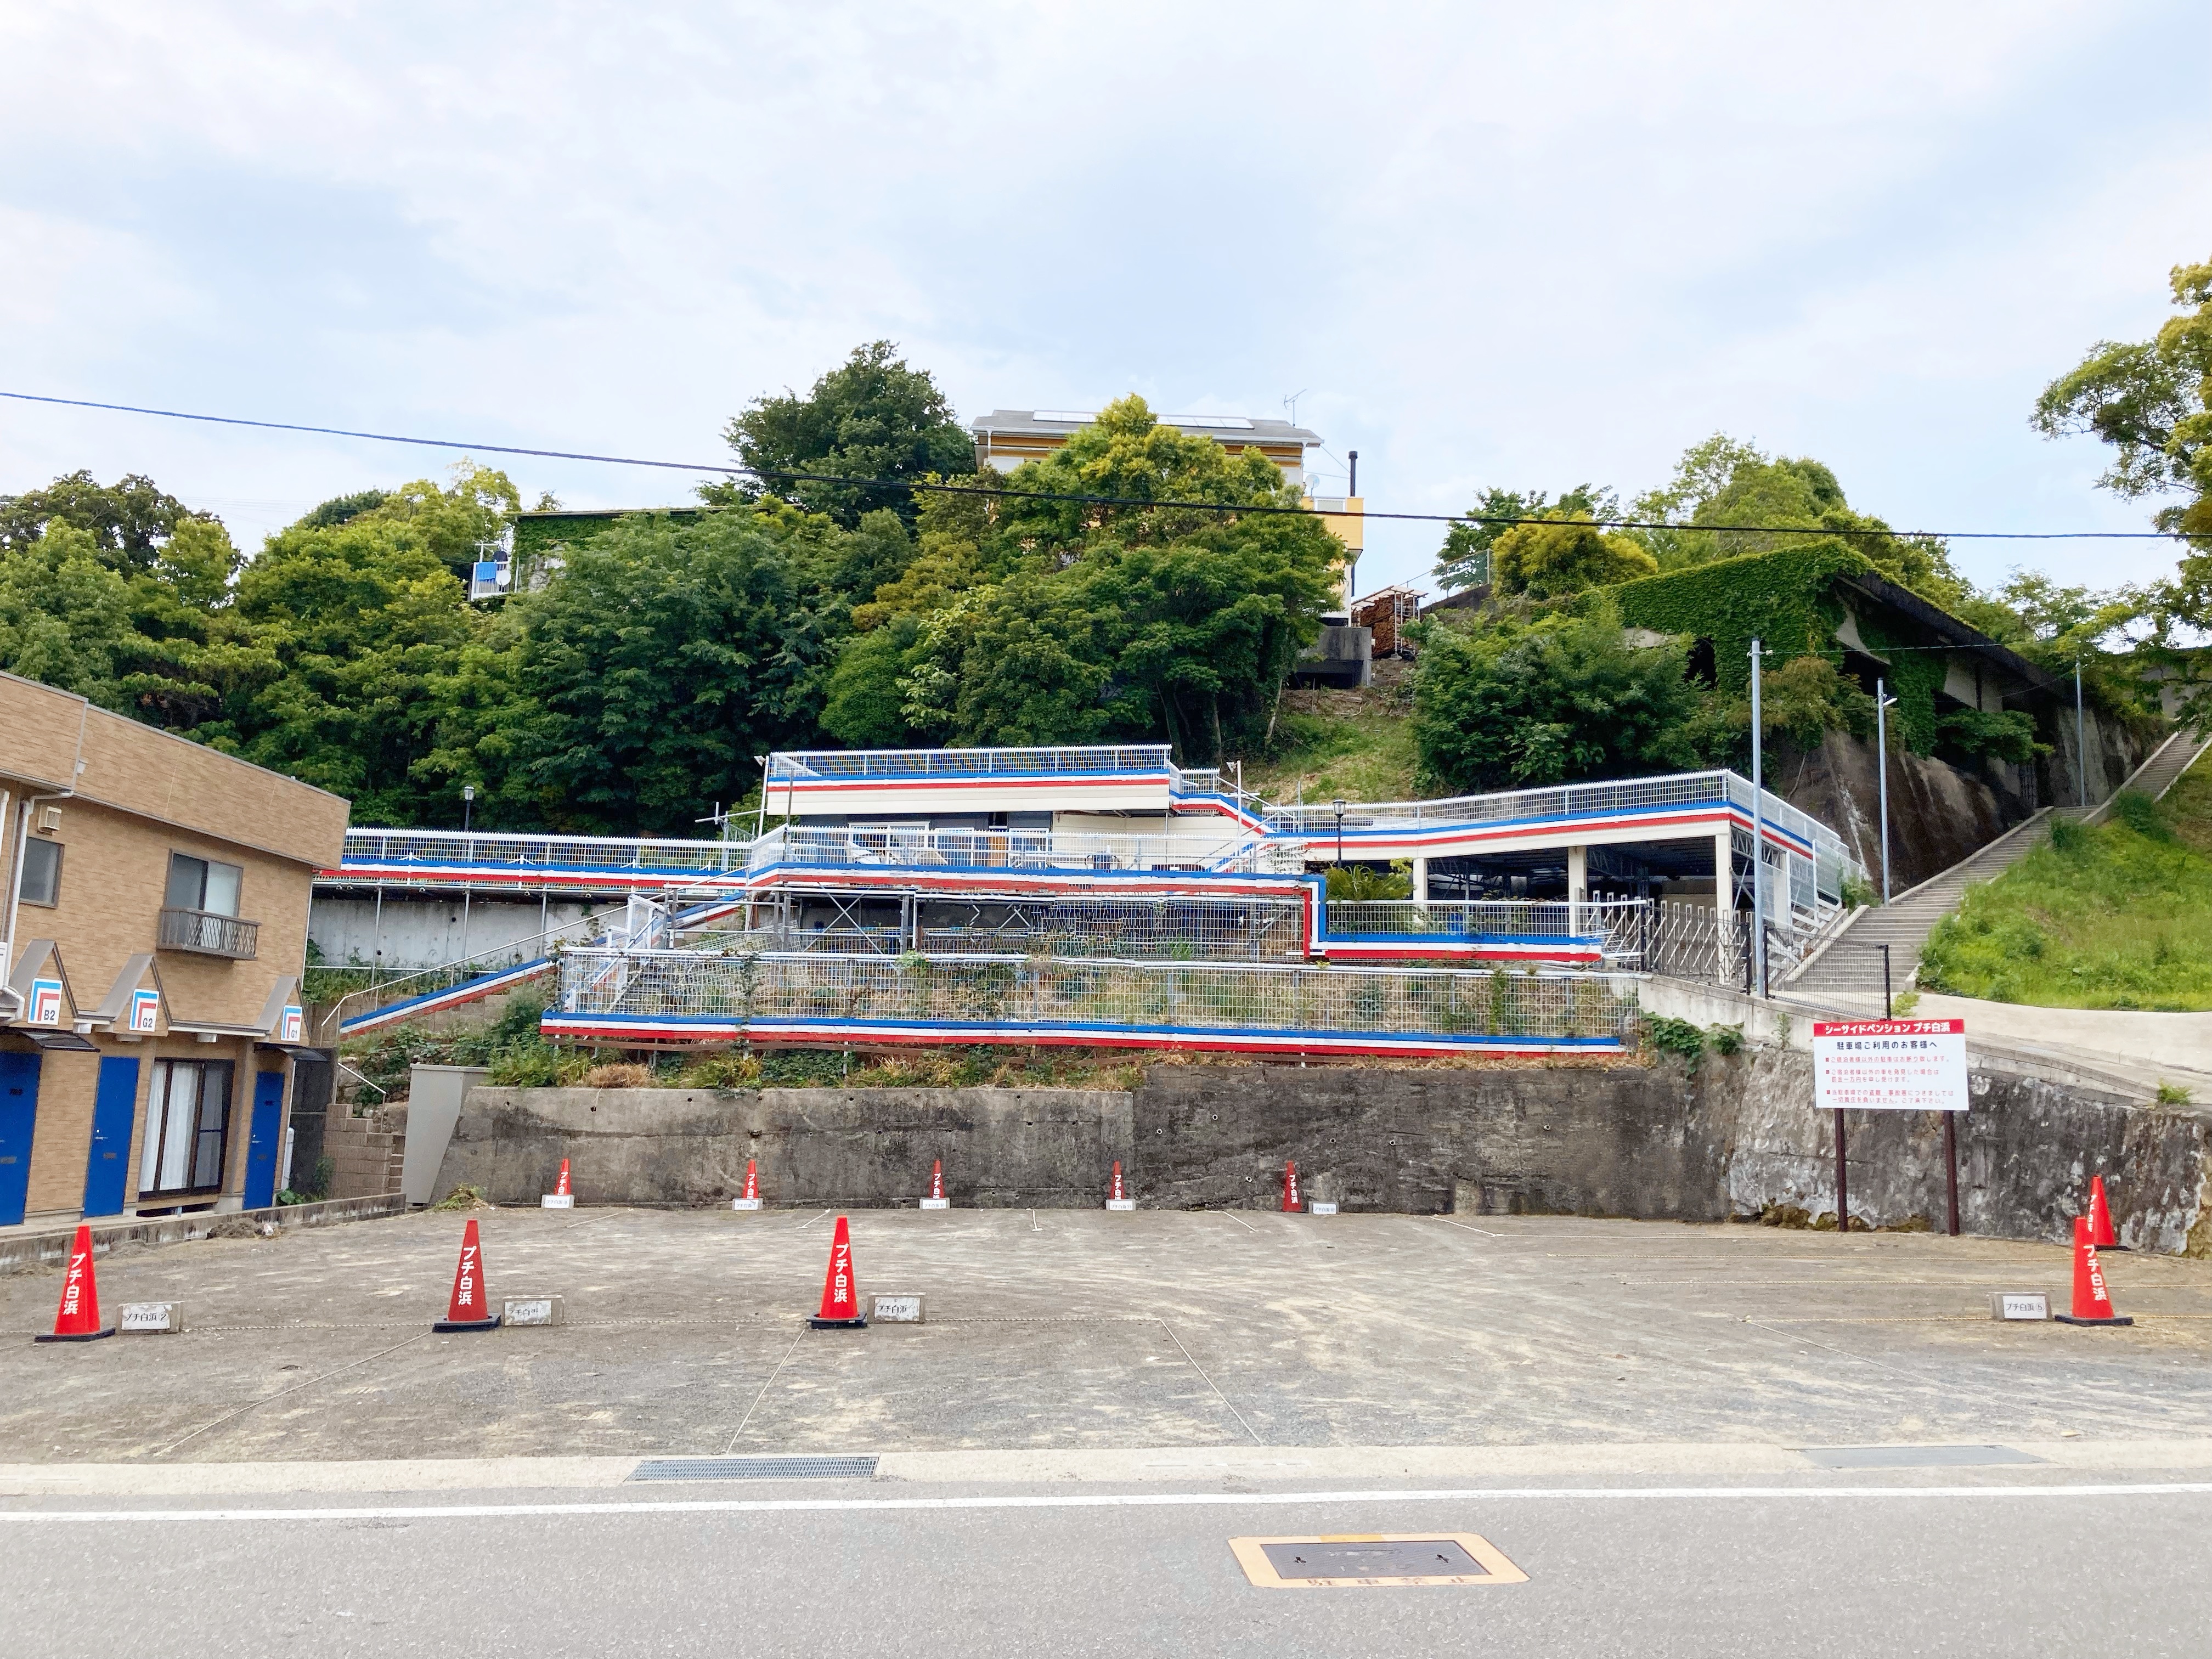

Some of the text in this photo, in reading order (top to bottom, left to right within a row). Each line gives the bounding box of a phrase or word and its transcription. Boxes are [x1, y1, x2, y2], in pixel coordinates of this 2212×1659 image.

[44, 1009, 55, 1020] B2
[143, 1018, 153, 1028] G2
[1825, 1022, 1950, 1034] シーサイドペンション プチ白浜
[1837, 1040, 1938, 1050] 駐車場ご利用のお客様へ
[458, 1245, 477, 1305] プチ白浜
[834, 1243, 849, 1303] プチ白浜
[63, 1253, 86, 1315] プチ白浜
